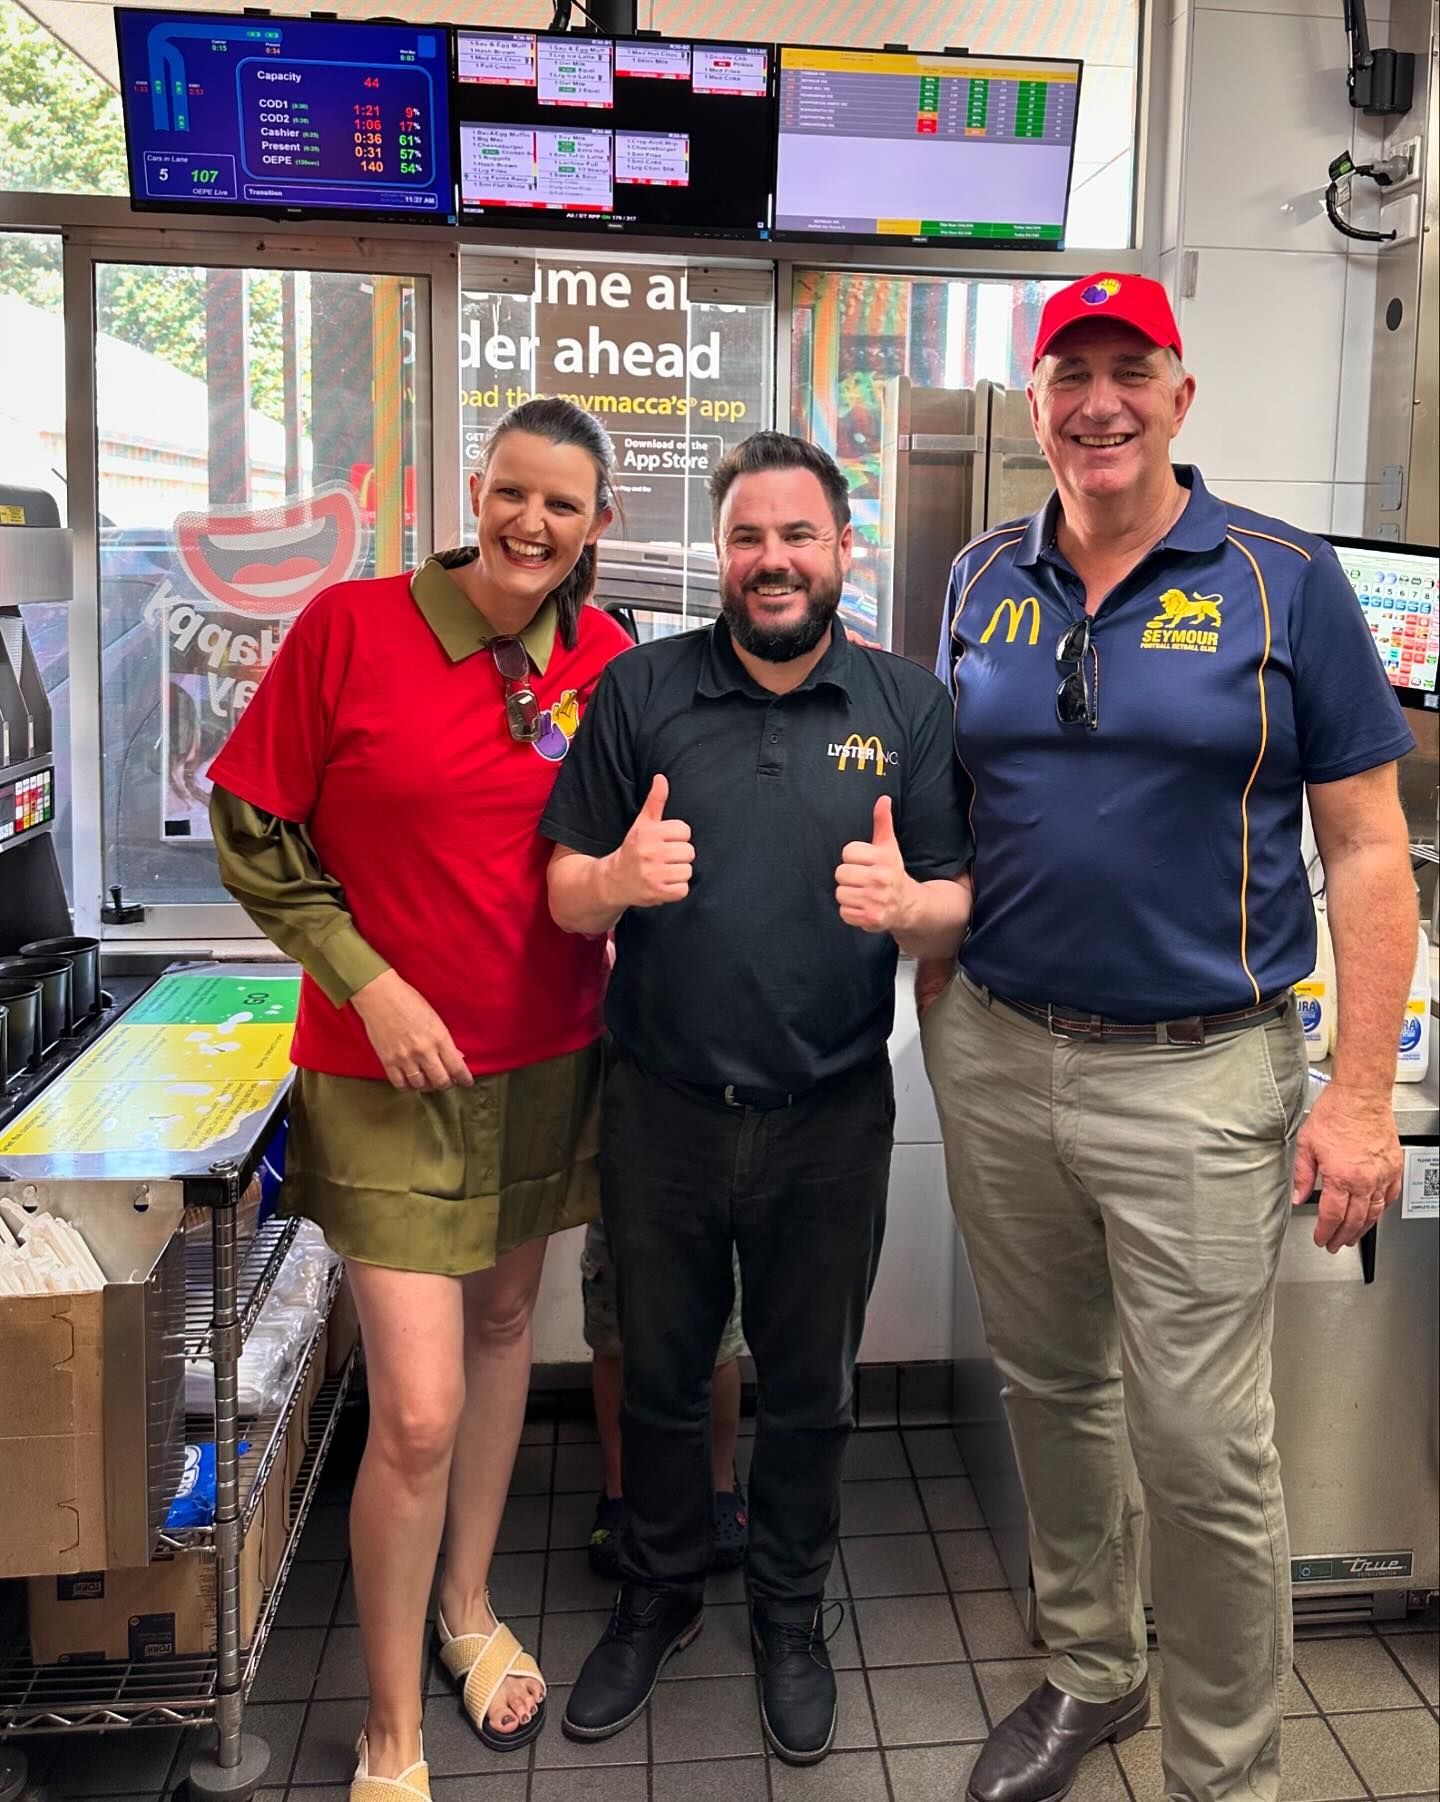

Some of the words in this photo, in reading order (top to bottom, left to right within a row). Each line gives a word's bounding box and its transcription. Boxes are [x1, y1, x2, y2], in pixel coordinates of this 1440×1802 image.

[257, 70, 301, 83] Capacity
[364, 77, 380, 88] 44
[259, 99, 288, 109] COD1
[354, 105, 380, 116] 1:21
[260, 113, 290, 124] COD2
[354, 119, 382, 130] 1:06
[261, 127, 300, 138] Cashier
[354, 132, 382, 144] 0:36
[399, 134, 422, 146] 61%
[261, 141, 300, 152] Present
[354, 147, 382, 158] 0:31
[400, 148, 422, 160] 57%
[262, 155, 292, 165] OEPE
[361, 161, 384, 172] 140
[400, 163, 422, 174] 54%
[159, 168, 168, 181] 5
[191, 170, 219, 183] 107
[192, 188, 213, 196] OEPE
[248, 188, 283, 196] Transition
[554, 326, 720, 379] ahead
[700, 399, 746, 422] app
[624, 438, 674, 450] Download
[691, 440, 708, 451] the
[624, 450, 661, 471] App
[662, 451, 708, 470] Store
[1142, 630, 1218, 646] SEYMOUR
[827, 744, 875, 760] LYSTER
[243, 992, 270, 1006] GO
